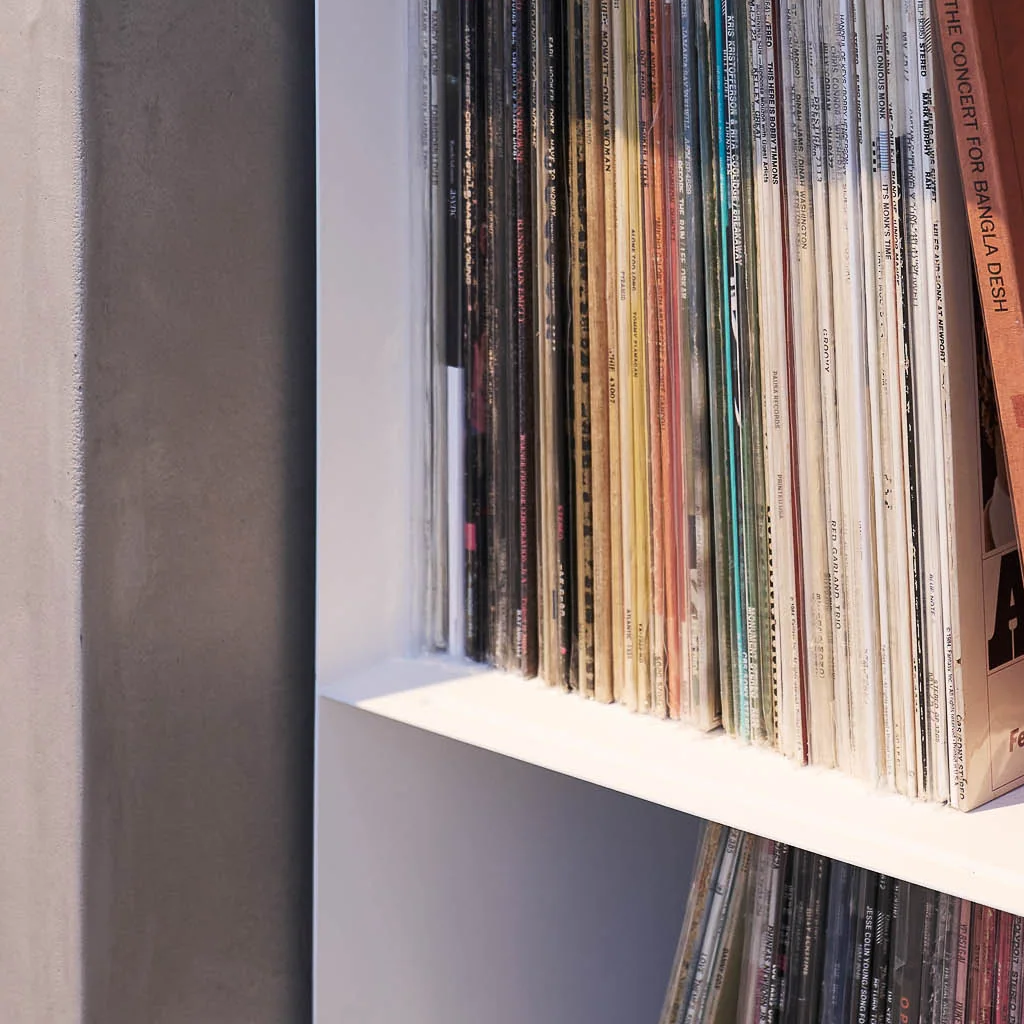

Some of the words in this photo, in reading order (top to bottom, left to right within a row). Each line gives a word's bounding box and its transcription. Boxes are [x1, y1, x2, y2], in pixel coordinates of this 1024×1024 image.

[727, 15, 735, 37] KRIS
[767, 62, 775, 81] THIS
[830, 45, 839, 73] CHRIS
[876, 32, 885, 91] THELONIOUS
[919, 42, 927, 77] STEREO
[726, 40, 737, 116] KRISTOFFERSON
[950, 40, 979, 131] CONCERT
[768, 106, 775, 115] IS
[878, 92, 886, 120] MONK
[921, 92, 929, 118] MARK
[731, 129, 739, 150] RITA
[754, 110, 762, 140] GREAT
[769, 116, 777, 145] BOBBY
[923, 120, 931, 157] MURPHY
[603, 129, 611, 172] WOMAN
[771, 146, 779, 185] TIMMONS
[963, 136, 984, 174] FOR
[881, 184, 889, 200] IT'S
[799, 190, 808, 250] WASHINGTON
[882, 202, 890, 237] MONK'S
[974, 180, 999, 257] BANGLA
[884, 239, 892, 261] TIME
[986, 262, 1009, 314] DESH
[938, 319, 946, 363] NEWPORT
[831, 547, 840, 599] GARLAND
[834, 605, 842, 630] TRIO
[865, 905, 873, 930] JESSE
[863, 932, 872, 956] COLIN
